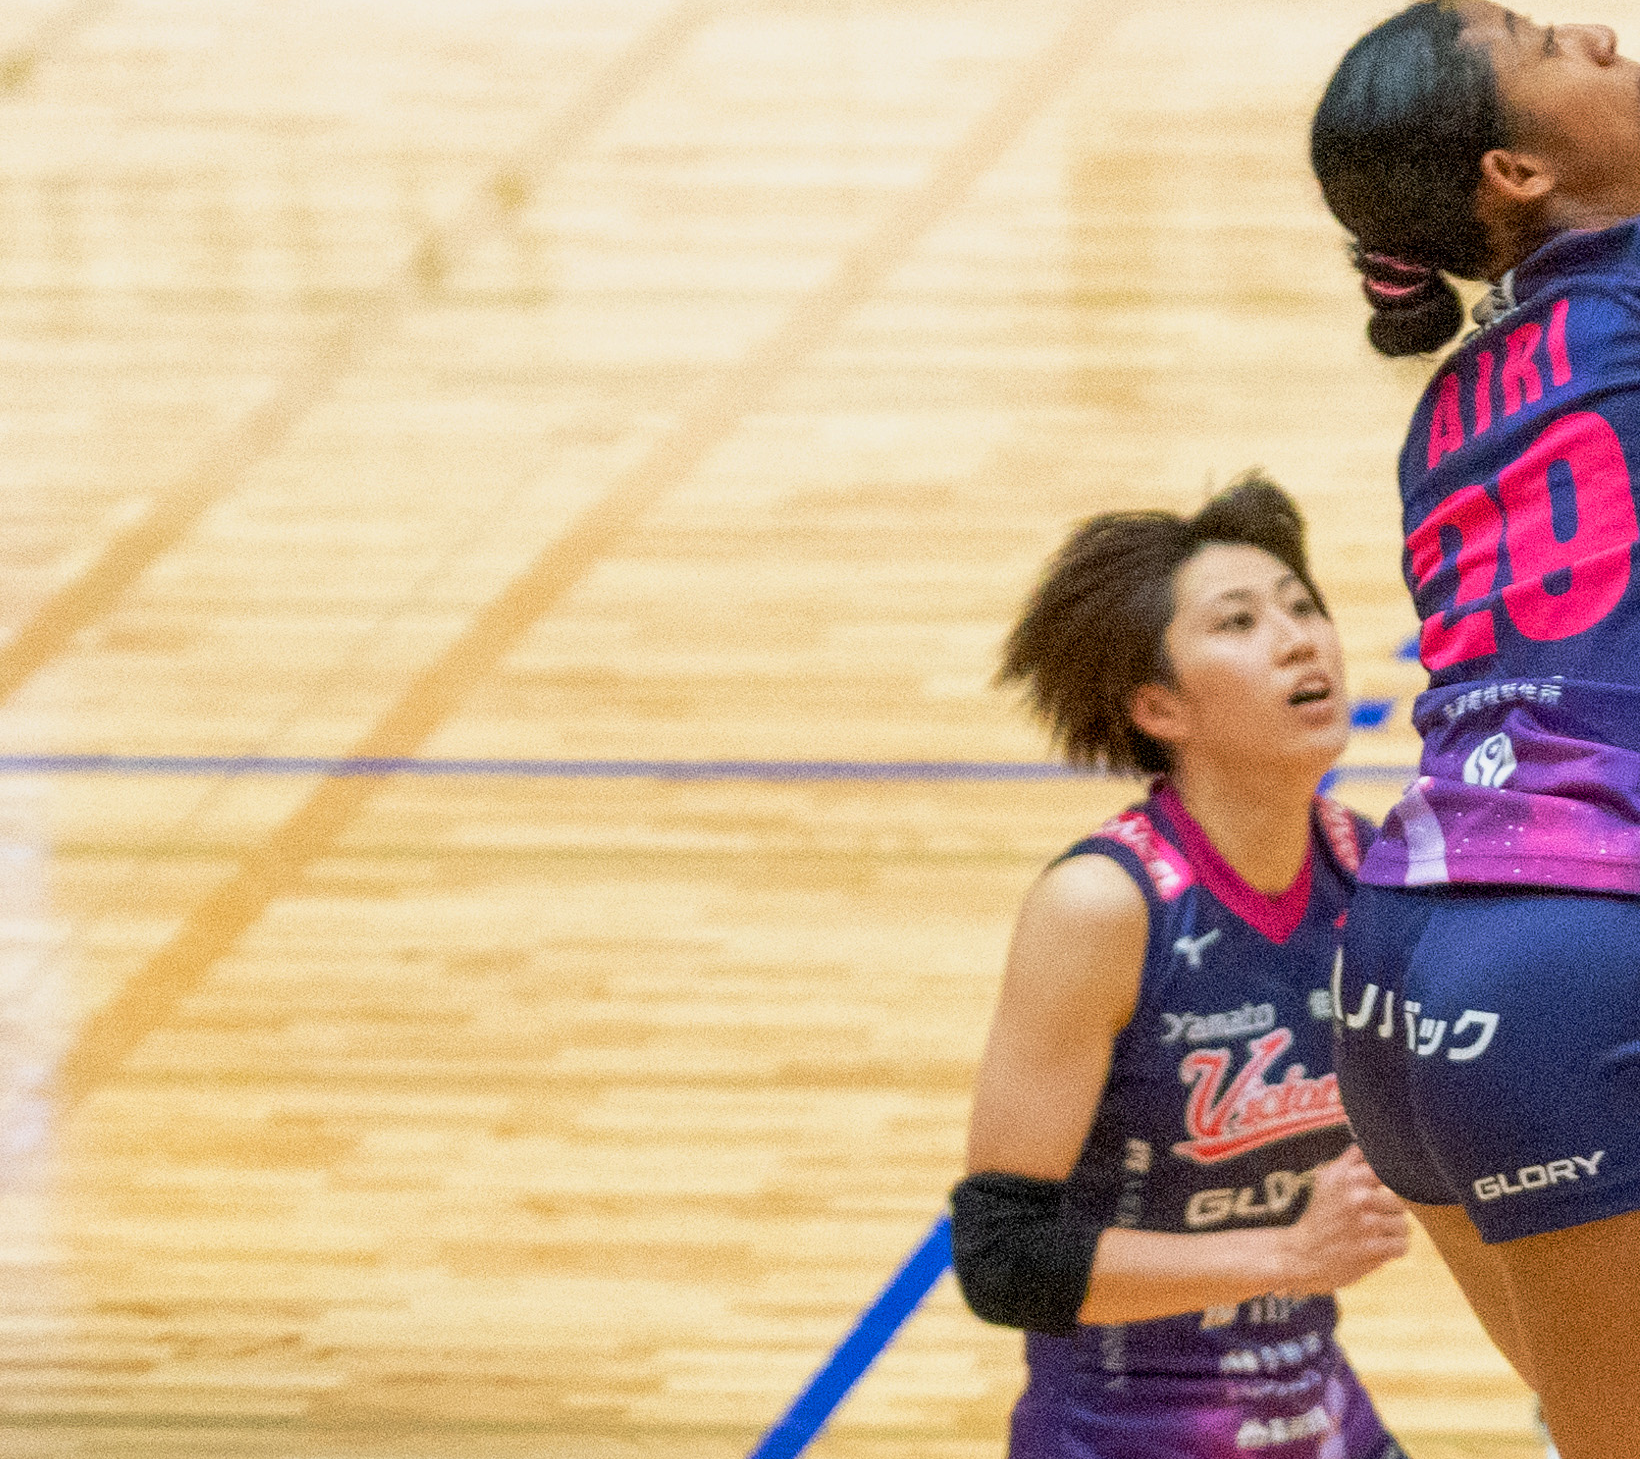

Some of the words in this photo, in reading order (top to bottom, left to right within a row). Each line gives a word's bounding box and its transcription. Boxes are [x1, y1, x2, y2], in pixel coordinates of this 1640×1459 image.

[1428, 299, 1572, 469] AIRI
[1407, 411, 1640, 670] 20
[1473, 1150, 1605, 1201] GLORY
